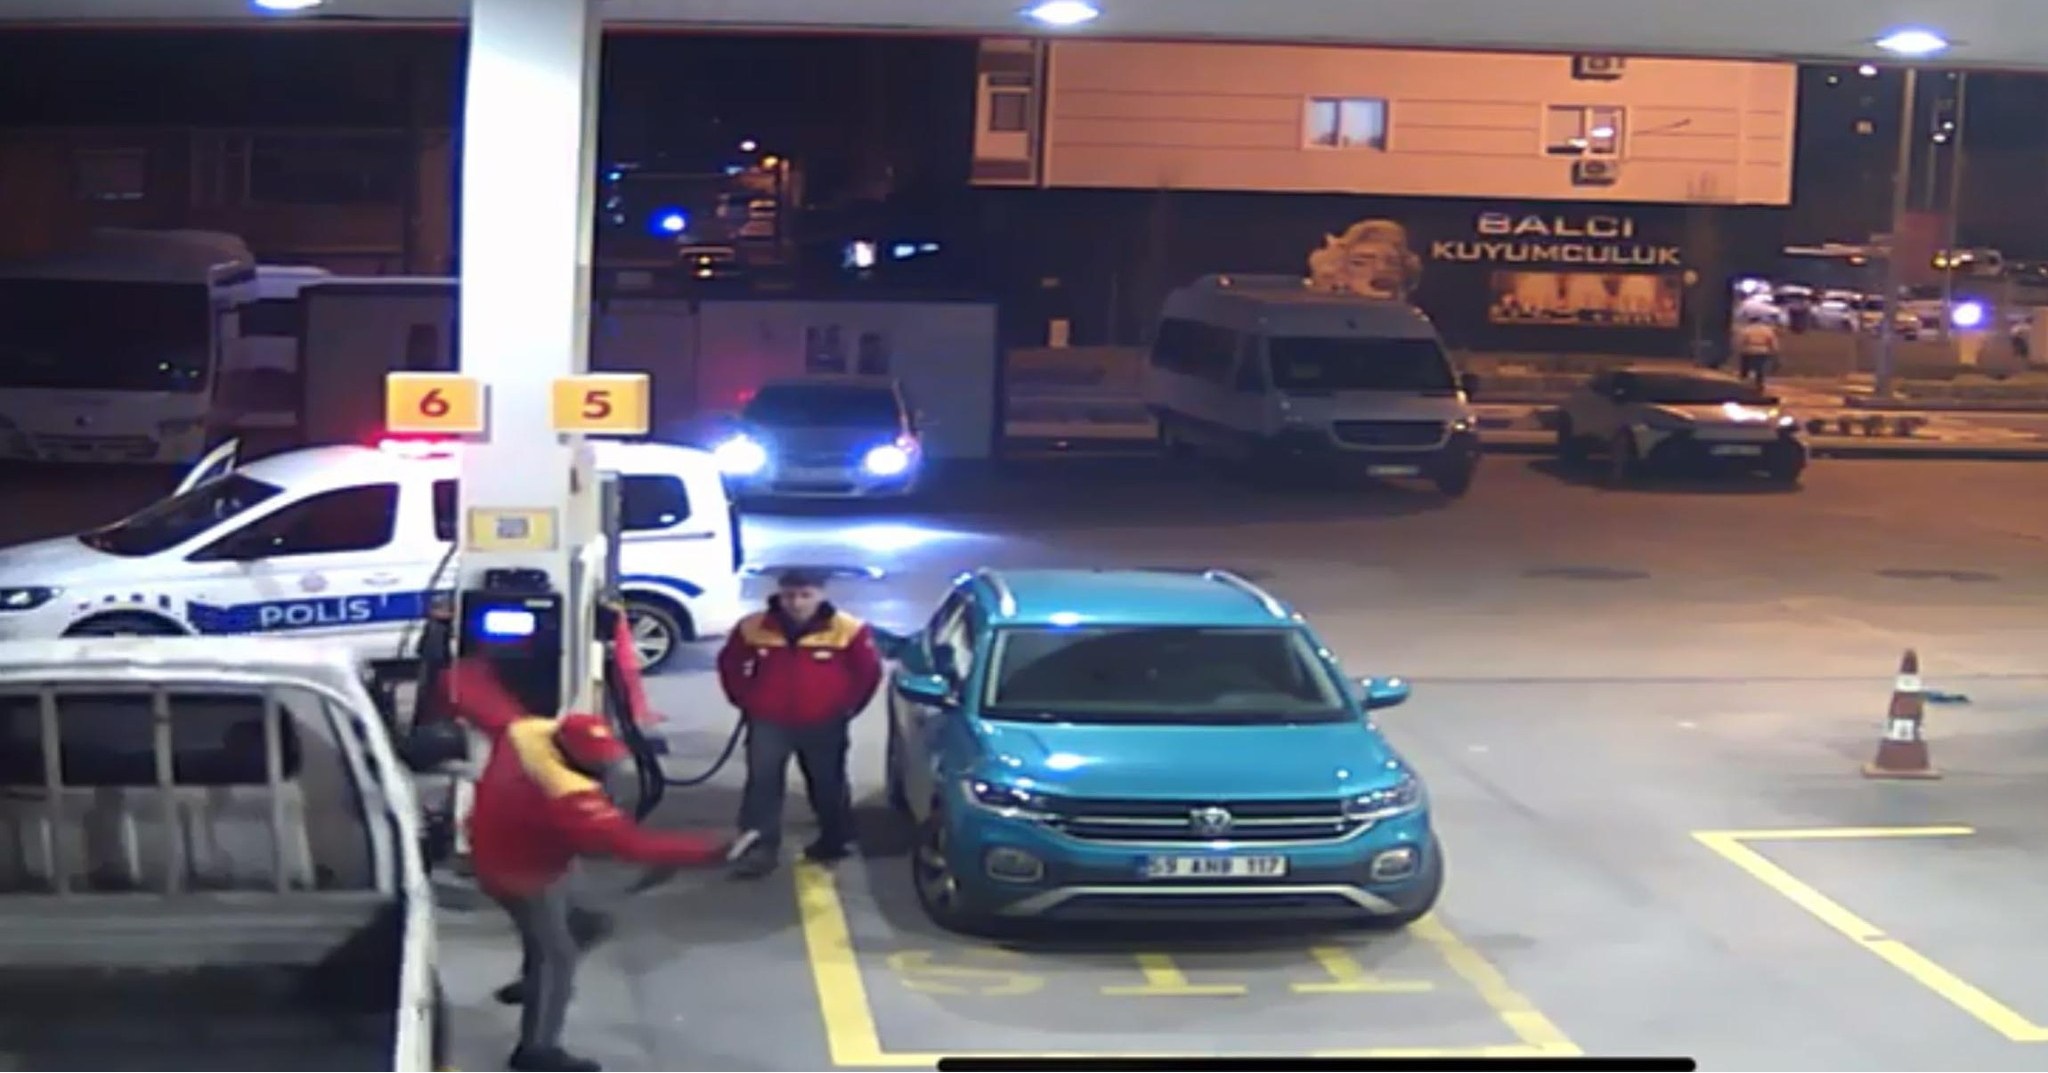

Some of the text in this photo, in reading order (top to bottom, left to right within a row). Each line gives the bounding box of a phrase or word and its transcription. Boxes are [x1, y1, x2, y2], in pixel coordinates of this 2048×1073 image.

[1476, 212, 1635, 238] BALCI
[1432, 241, 1681, 265] KUYUMCULUK
[419, 388, 450, 418] 6
[582, 390, 612, 420] 5
